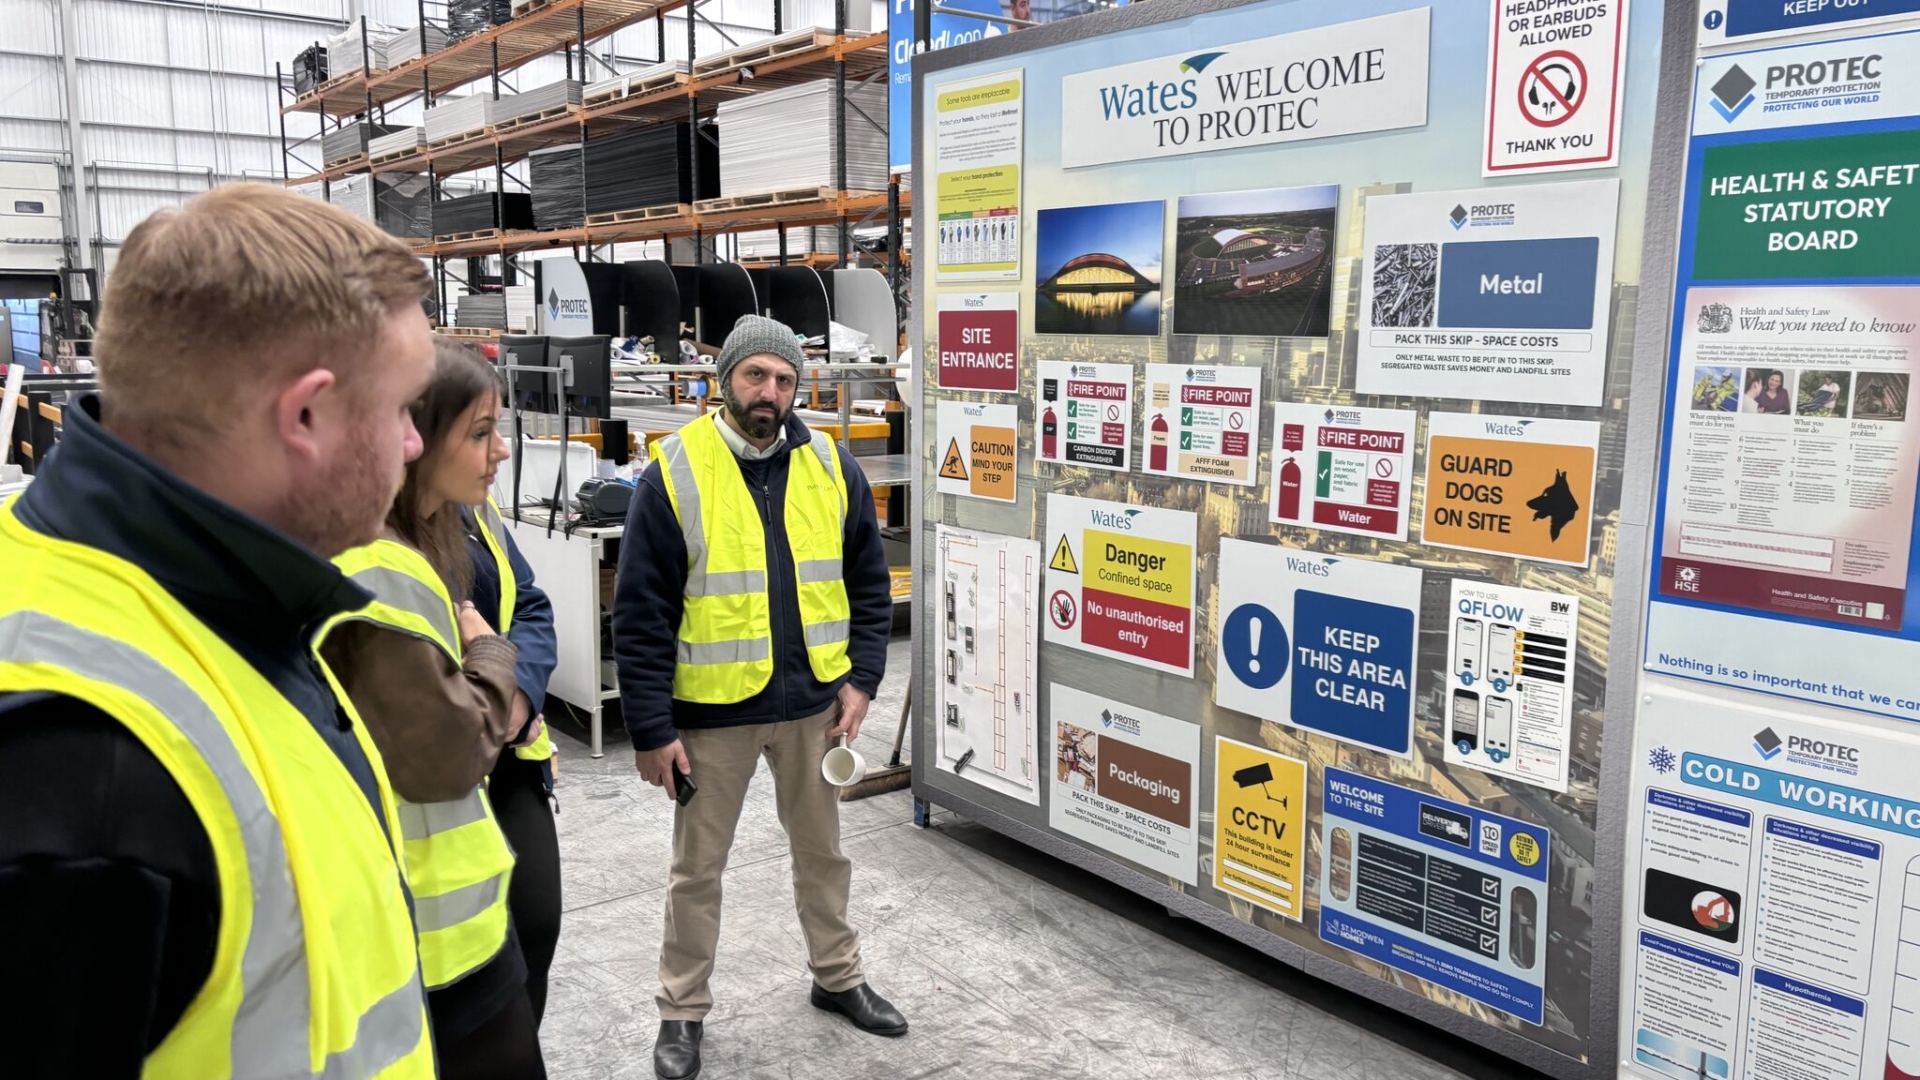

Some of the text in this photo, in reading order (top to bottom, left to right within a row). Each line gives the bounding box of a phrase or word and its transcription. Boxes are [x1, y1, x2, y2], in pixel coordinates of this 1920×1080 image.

[1784, 0, 1830, 16] KEEP
[1508, 4, 1607, 32] OR EARBUDS
[1519, 24, 1592, 47] ALLOWED
[1765, 54, 1882, 90] PROTEC
[1100, 48, 1386, 120] Wates WELCOME
[1764, 81, 1880, 100] TEMPORARY PROTECTION
[1763, 95, 1880, 112] PROTECTING OUR WORLD
[1154, 97, 1319, 148] TO PROTEC
[1506, 134, 1593, 154] THANK YOU
[1711, 172, 1805, 196] HEALTH
[1812, 170, 1828, 190] &
[1471, 204, 1515, 216] PROTEC
[1744, 197, 1892, 223] STATUTORY
[1768, 230, 1858, 252] BOARD
[1480, 272, 1543, 294] Metal
[561, 300, 587, 313] PROTEC
[964, 298, 984, 307] Wates
[1740, 307, 1766, 315] Health
[1768, 307, 1783, 315] and
[1785, 307, 1810, 317] Safety
[1739, 317, 1916, 334] What you need to know
[962, 328, 991, 344] SITE
[1395, 334, 1422, 344] PACK
[1424, 335, 1446, 344] THIS
[1449, 335, 1472, 345] SKIP
[1482, 336, 1516, 346] SPACE
[1520, 336, 1558, 347] COSTS
[942, 352, 1014, 369] ENTRANCE
[1074, 384, 1125, 397] FIRE POINT
[1189, 389, 1250, 403] FIRE POINT
[964, 406, 982, 416] Wates
[1336, 411, 1361, 419] PROTEC
[1485, 422, 1524, 436] Wates
[972, 441, 1014, 456] CAUTION
[1327, 432, 1401, 449] FIRE POINT
[1073, 445, 1116, 456] CARBON DIOXIDE
[1076, 454, 1113, 463] EXTINGUISHER
[972, 458, 1013, 471] MIND YOUR
[1191, 466, 1234, 476] EXTINGUISHER
[1440, 454, 1512, 477] GUARD
[982, 473, 1001, 483] STEP
[1446, 482, 1503, 504] DOGS
[1091, 510, 1131, 530] Wates
[1338, 510, 1372, 525] Water
[1434, 507, 1511, 534] ON SITE
[1106, 543, 1166, 572] Danger
[1286, 557, 1329, 577] Wates
[1098, 568, 1172, 593] Confined space
[1674, 581, 1700, 592] HSE
[1550, 601, 1569, 612] BW
[1772, 588, 1793, 597] Health
[1808, 593, 1828, 603] Safety
[1830, 596, 1863, 607] Executive
[1087, 600, 1184, 634] No unauthorised
[1458, 599, 1524, 622] QFLOW
[1118, 630, 1148, 649] entry
[1324, 626, 1380, 654] KEEP
[1298, 646, 1406, 690] THIS AREA
[1659, 653, 1713, 675] Nothing
[1718, 664, 1728, 675] is
[1732, 668, 1748, 679] so
[1752, 670, 1828, 694] important
[1832, 684, 1864, 700] that
[1869, 694, 1891, 705] we
[1316, 678, 1385, 712] CLEAR
[1114, 713, 1140, 728] PROTEC
[1788, 735, 1859, 762] PROTEC
[1787, 757, 1821, 767] PROTECTING
[1836, 765, 1857, 775] WORLD
[1109, 762, 1180, 804] Packaging
[1329, 780, 1384, 805] WELCOME
[1685, 760, 1760, 791] COLD
[1779, 779, 1920, 829] WORKING
[1072, 791, 1088, 803] PACK
[1090, 798, 1104, 809] THIS
[1105, 804, 1120, 814] SKIP
[1125, 811, 1146, 826] SPACE
[1147, 820, 1171, 835] COSTS
[1330, 792, 1384, 818] TO THE SITE
[1232, 806, 1286, 840] CCTV
[1423, 812, 1454, 827] DELIVERY
[1483, 825, 1499, 841] 10
[1224, 827, 1238, 839] This
[1238, 832, 1265, 850] building
[1273, 846, 1293, 859] under
[1482, 839, 1498, 849] SPEED
[1226, 838, 1291, 868] 24 hour surveillance
[1340, 930, 1364, 945] HOMES
[1350, 927, 1384, 945] MODWEN
[1785, 982, 1832, 1002] Hypothermia
